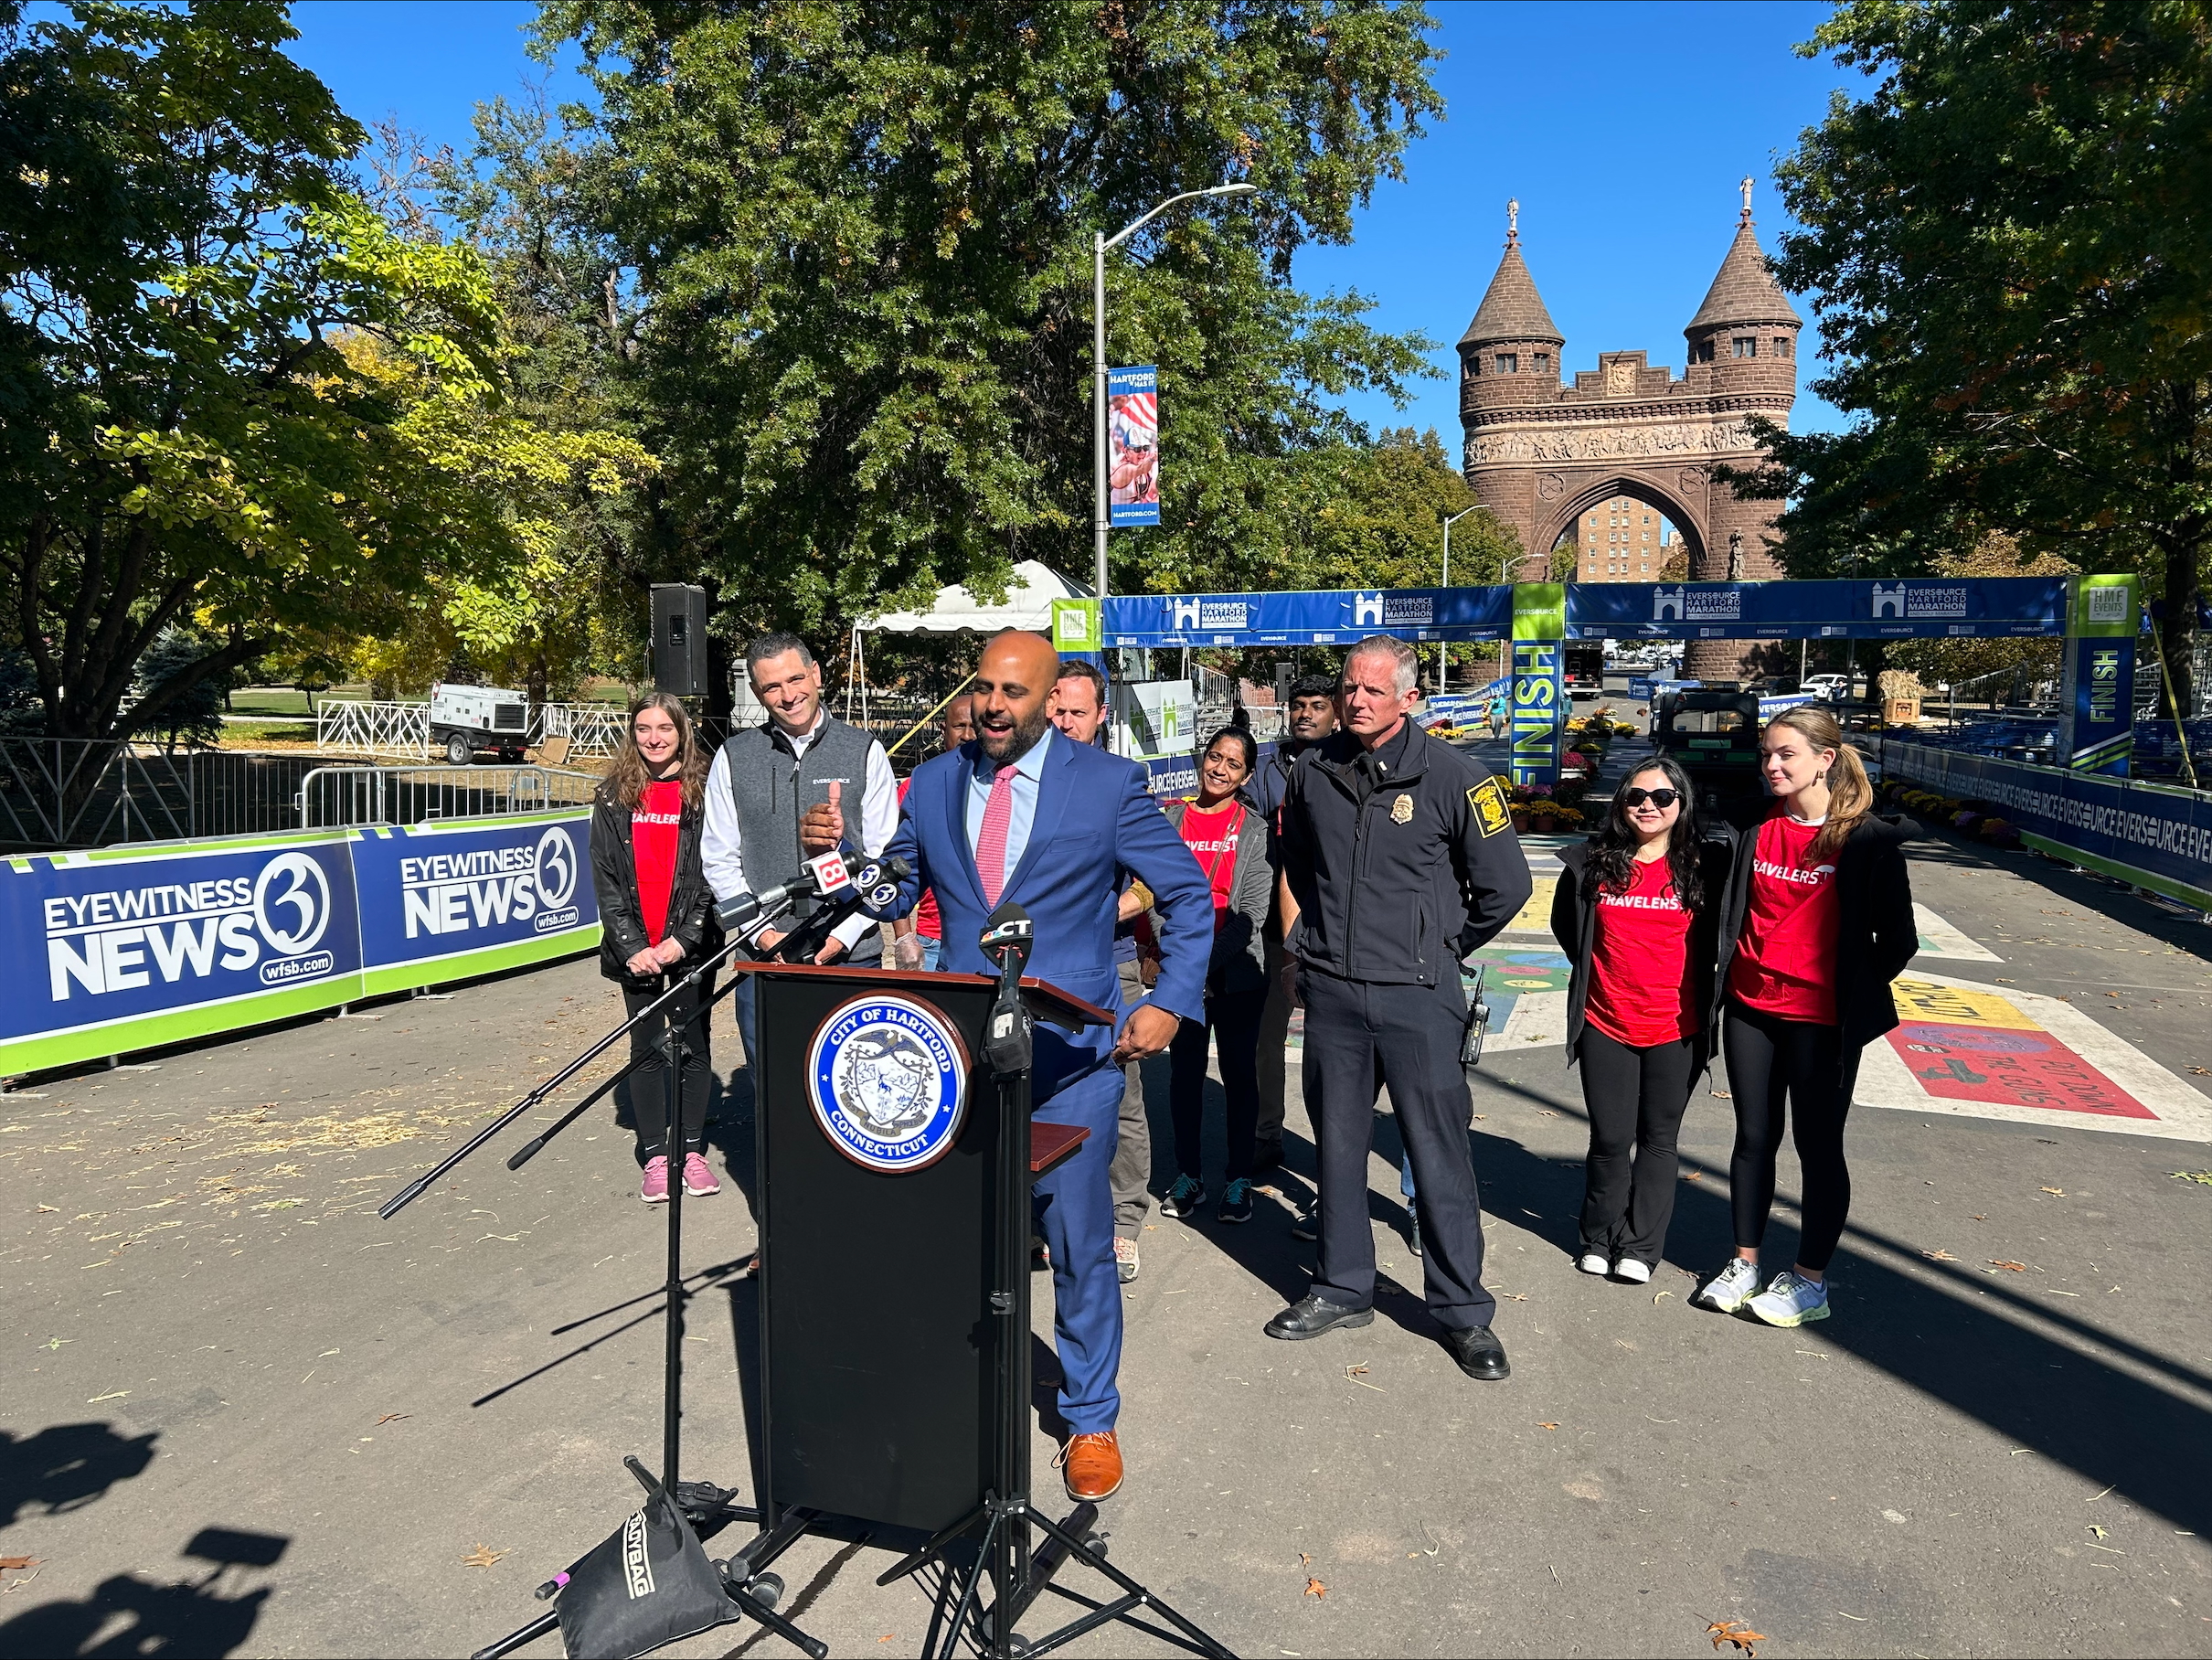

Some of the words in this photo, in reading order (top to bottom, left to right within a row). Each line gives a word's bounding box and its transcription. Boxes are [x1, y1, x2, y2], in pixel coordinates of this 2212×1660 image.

[1110, 373, 1154, 384] HARTFORD
[1909, 588, 1966, 596] EVERSOURCE
[2095, 591, 2123, 602] HMF
[2094, 603, 2122, 612] EVENTS
[2090, 649, 2119, 723] FINISH
[1513, 644, 1555, 785] FINISH
[1978, 778, 2014, 807] EVERSOURCE
[2015, 787, 2058, 820] EVERSOURCE
[2058, 796, 2117, 835] EVERSOURCE
[2116, 809, 2188, 856] EVERSOURCE
[400, 846, 535, 883] EYEWITNESS
[821, 863, 844, 883] 8
[1752, 858, 1819, 885] RAVELERS
[44, 877, 253, 930] EYEWITNESS
[403, 875, 536, 940] NEWS
[1600, 892, 1678, 910] TRAVELERS
[537, 912, 576, 928] wfsb.com
[998, 920, 1031, 936] CT
[47, 913, 260, 1002] NEWS
[266, 957, 329, 979] wfsb.com
[830, 1016, 859, 1046] CITY
[861, 1008, 882, 1023] OF
[886, 1009, 952, 1073] HARTFORD
[1977, 1055, 2028, 1072] THE
[2034, 1059, 2090, 1080] PUT
[1998, 1075, 2067, 1104] GUNS
[2058, 1081, 2126, 1112] DOWN
[843, 1097, 860, 1114] POST
[863, 1121, 896, 1135] NUBILA
[831, 1110, 930, 1157] CONNECTICUT
